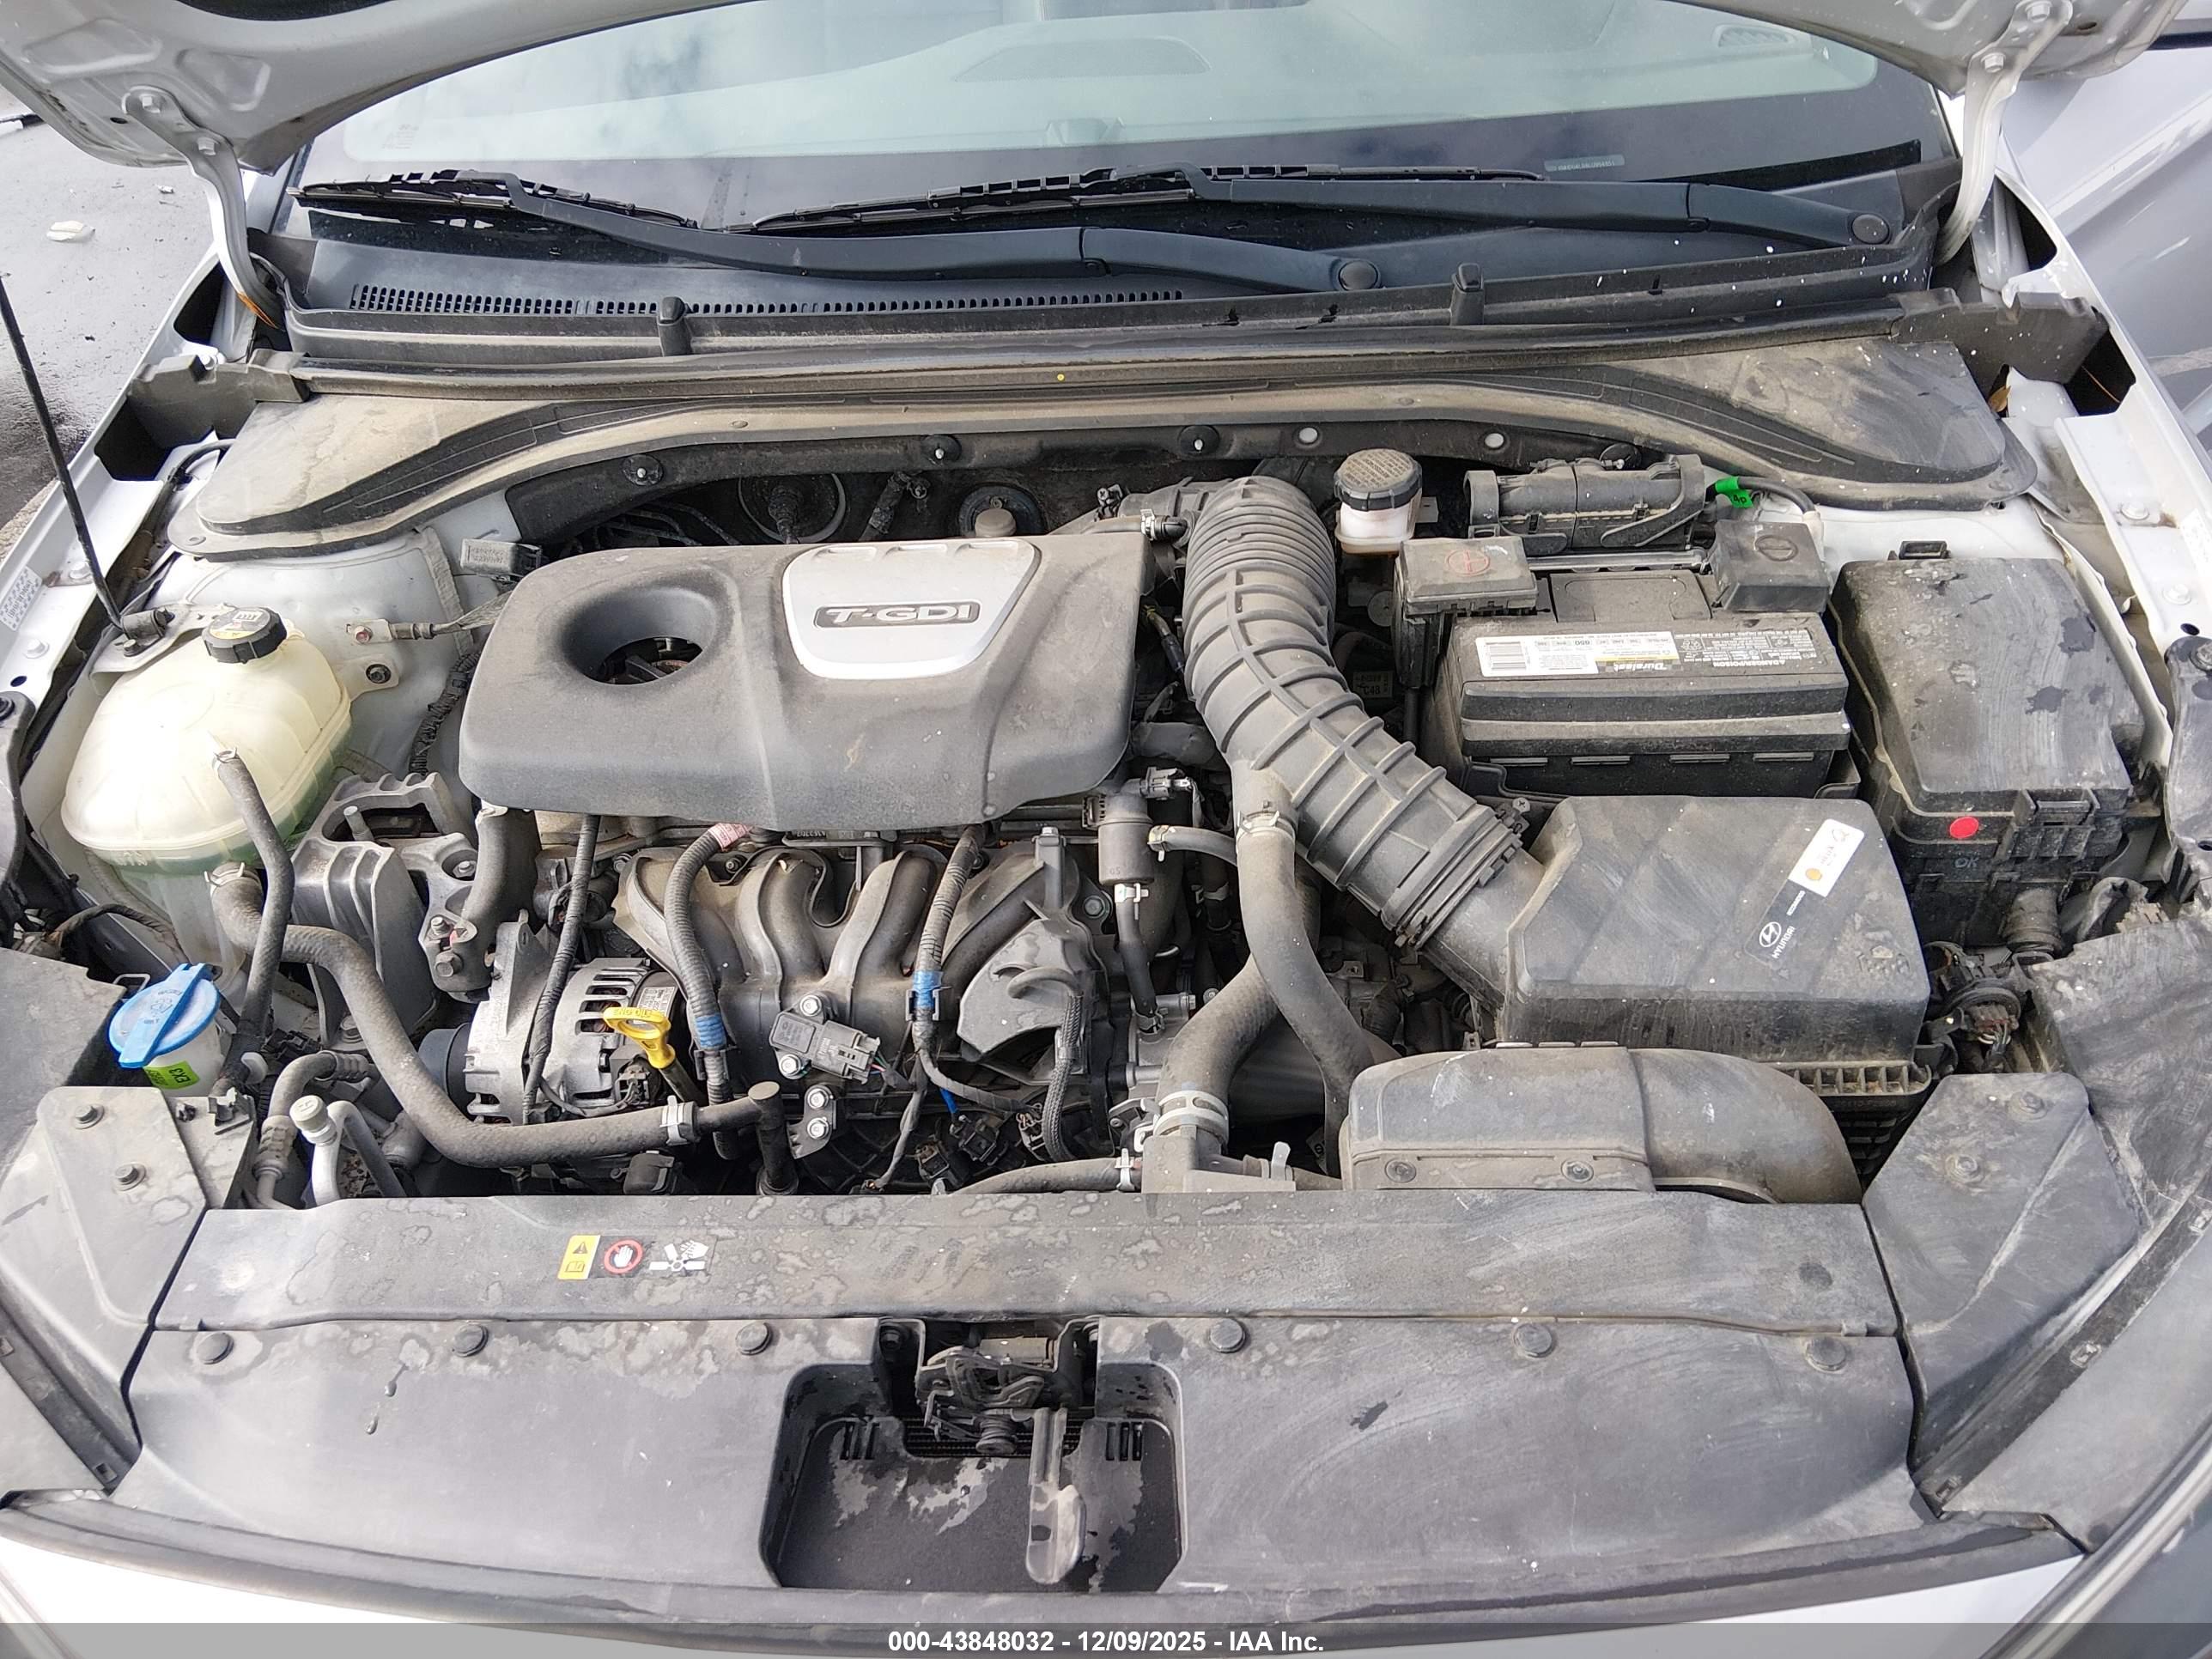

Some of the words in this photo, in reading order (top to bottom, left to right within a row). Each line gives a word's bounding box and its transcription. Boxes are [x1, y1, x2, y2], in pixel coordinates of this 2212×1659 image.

[826, 604, 972, 623] T-GDI
[1613, 662, 1668, 672] Duralast
[1771, 926, 1796, 959] HYUNDAI
[168, 1068, 191, 1084] EX3
